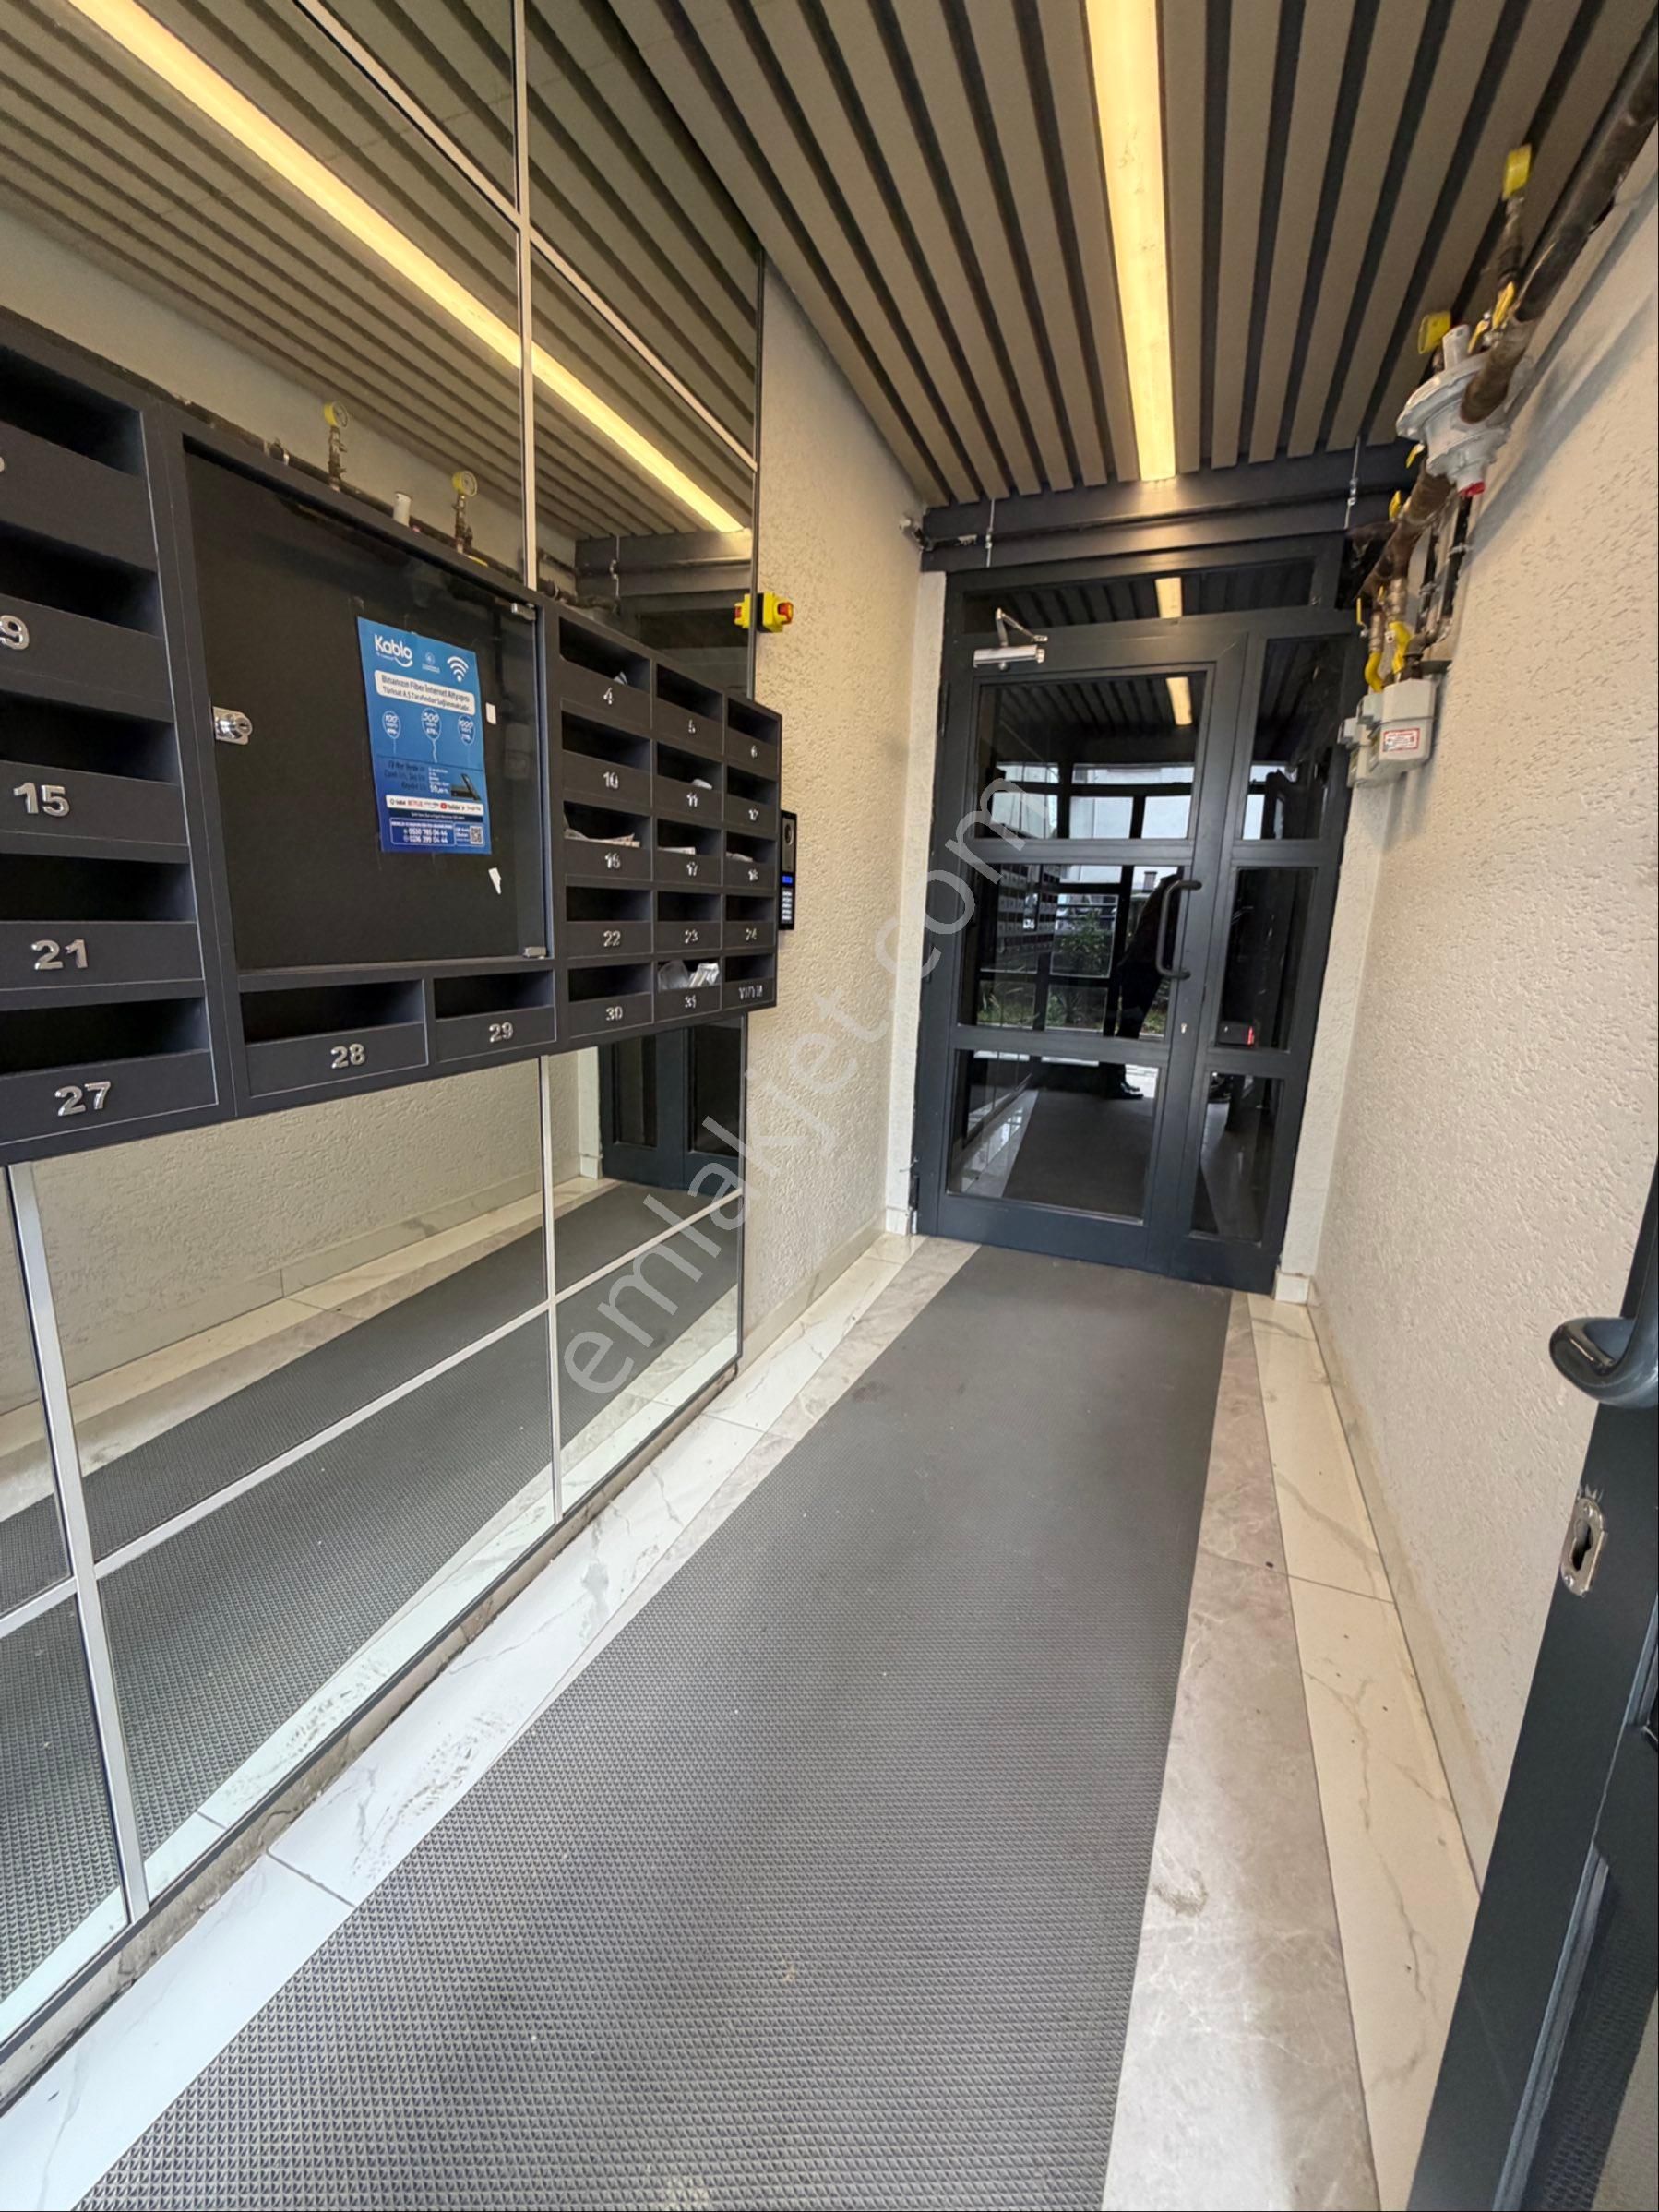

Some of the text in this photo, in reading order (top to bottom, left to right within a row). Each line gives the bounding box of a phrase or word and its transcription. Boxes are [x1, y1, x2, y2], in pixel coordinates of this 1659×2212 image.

[375, 634, 413, 660] Kablo
[603, 687, 615, 705] 4
[687, 719, 696, 734] 5
[750, 745, 758, 759] 6
[603, 771, 619, 789] 10
[13, 783, 70, 818] 15
[686, 792, 698, 807] 11
[604, 852, 621, 869] 16
[686, 861, 698, 876] 17
[748, 868, 758, 881] 18
[603, 929, 621, 948] 22
[684, 929, 699, 944] 23
[746, 928, 758, 941] 24
[30, 939, 89, 970] 21
[684, 994, 697, 1009] 31
[605, 1006, 624, 1022] 30
[489, 1022, 514, 1043] 29
[331, 1043, 365, 1070] 28
[54, 1081, 112, 1117] 27
